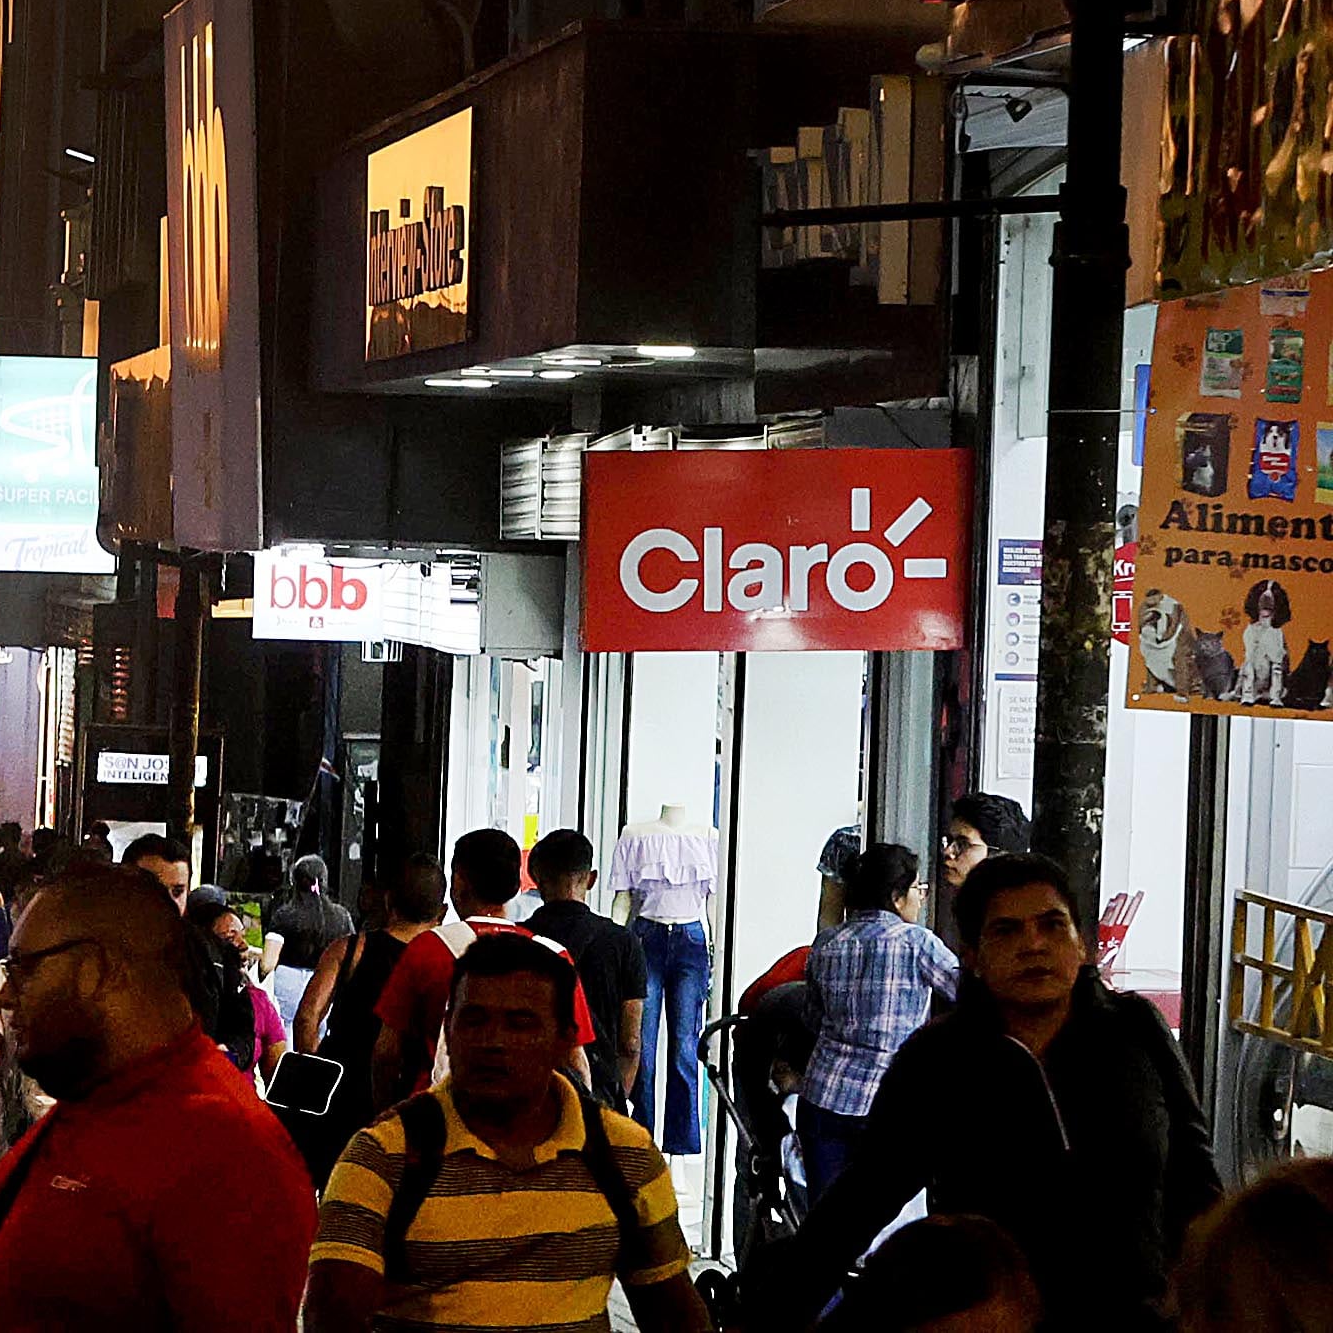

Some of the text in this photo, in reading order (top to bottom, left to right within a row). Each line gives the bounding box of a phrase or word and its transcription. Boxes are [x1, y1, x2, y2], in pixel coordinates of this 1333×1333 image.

[4, 529, 89, 570] Tropical
[619, 527, 895, 613] Claro
[1164, 547, 1234, 568] para
[270, 564, 369, 611] bbb
